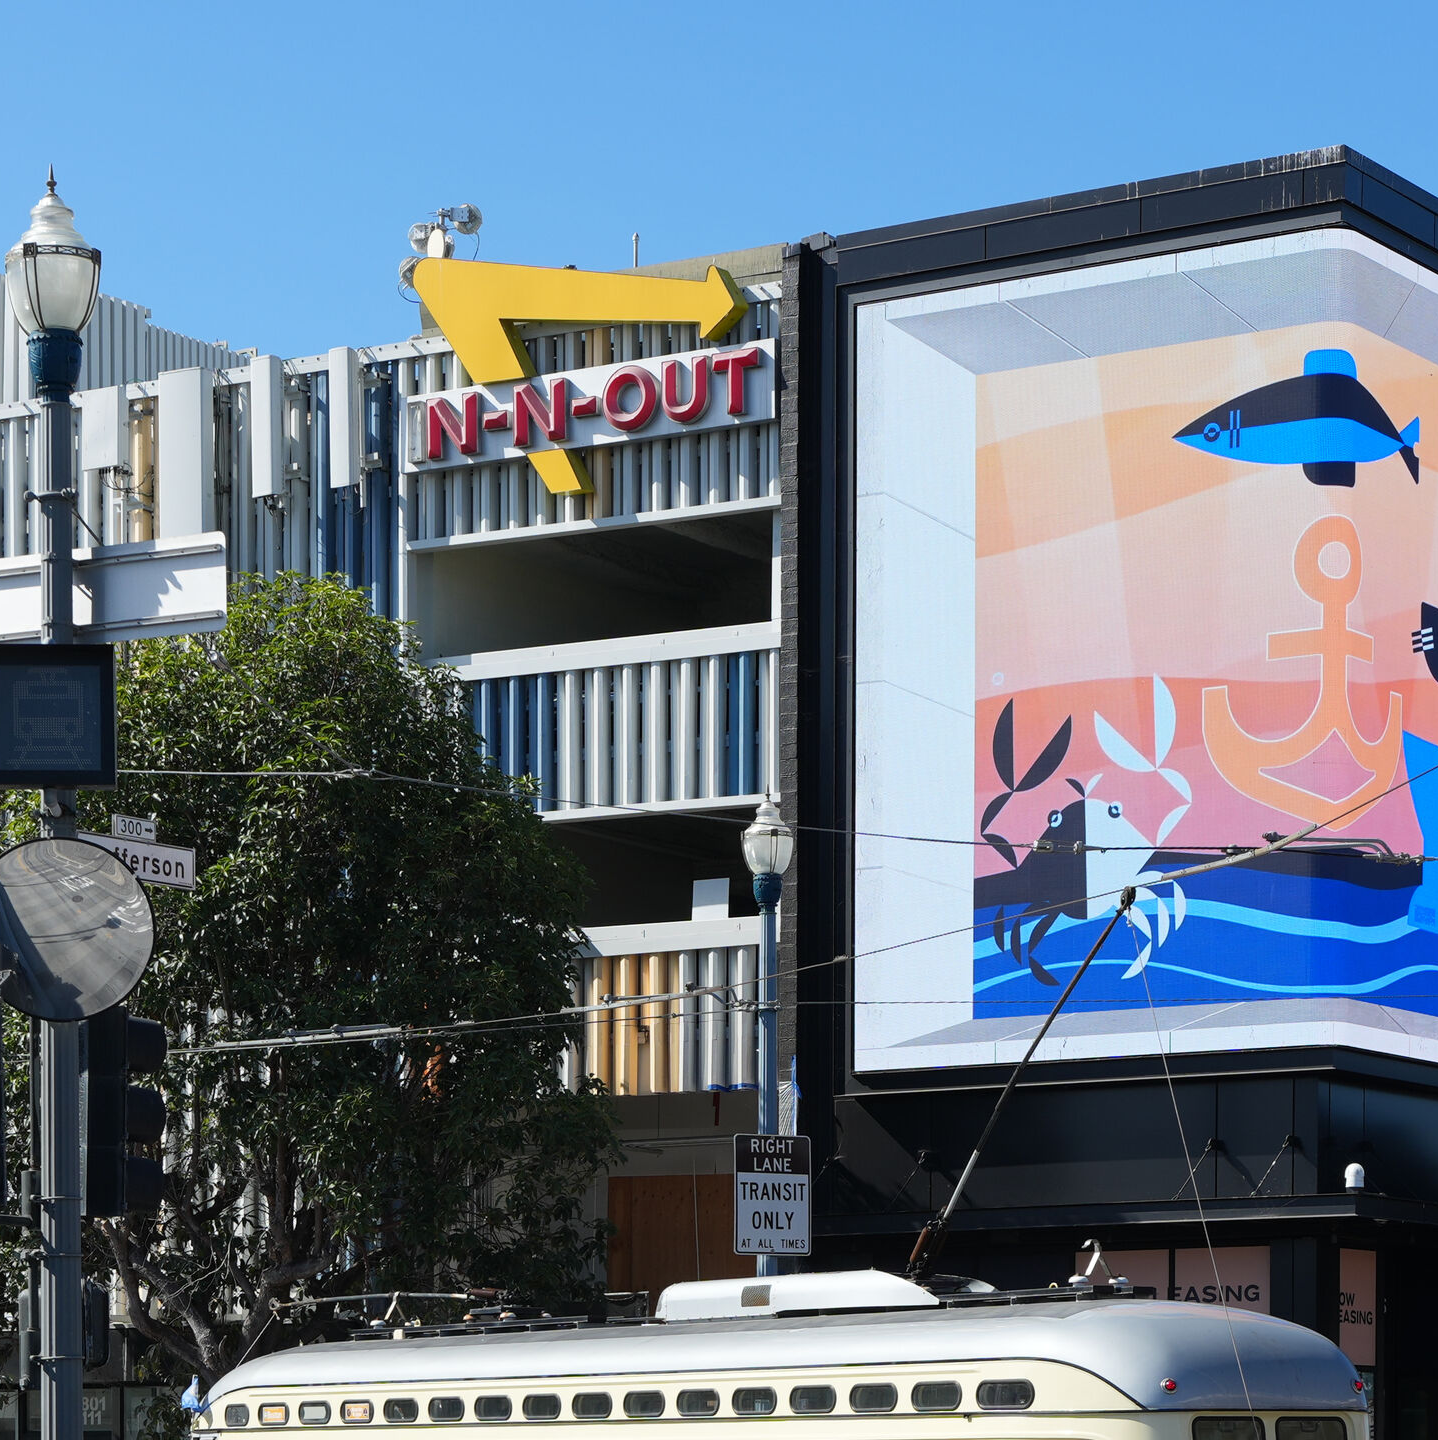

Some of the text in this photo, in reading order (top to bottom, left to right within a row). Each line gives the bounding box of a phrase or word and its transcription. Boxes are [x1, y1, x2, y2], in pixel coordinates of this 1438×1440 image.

[120, 819, 142, 836] 300
[114, 846, 185, 879] ferson
[750, 1138, 794, 1154] RIGHT
[753, 1156, 792, 1172] LANE
[739, 1181, 806, 1202] TRANSIT
[751, 1210, 795, 1230] ONLY
[741, 1238, 806, 1250] AT ALL TIMES
[1168, 1284, 1260, 1304] EASING
[1338, 1292, 1355, 1306] OW
[1338, 1309, 1373, 1325] EASING
